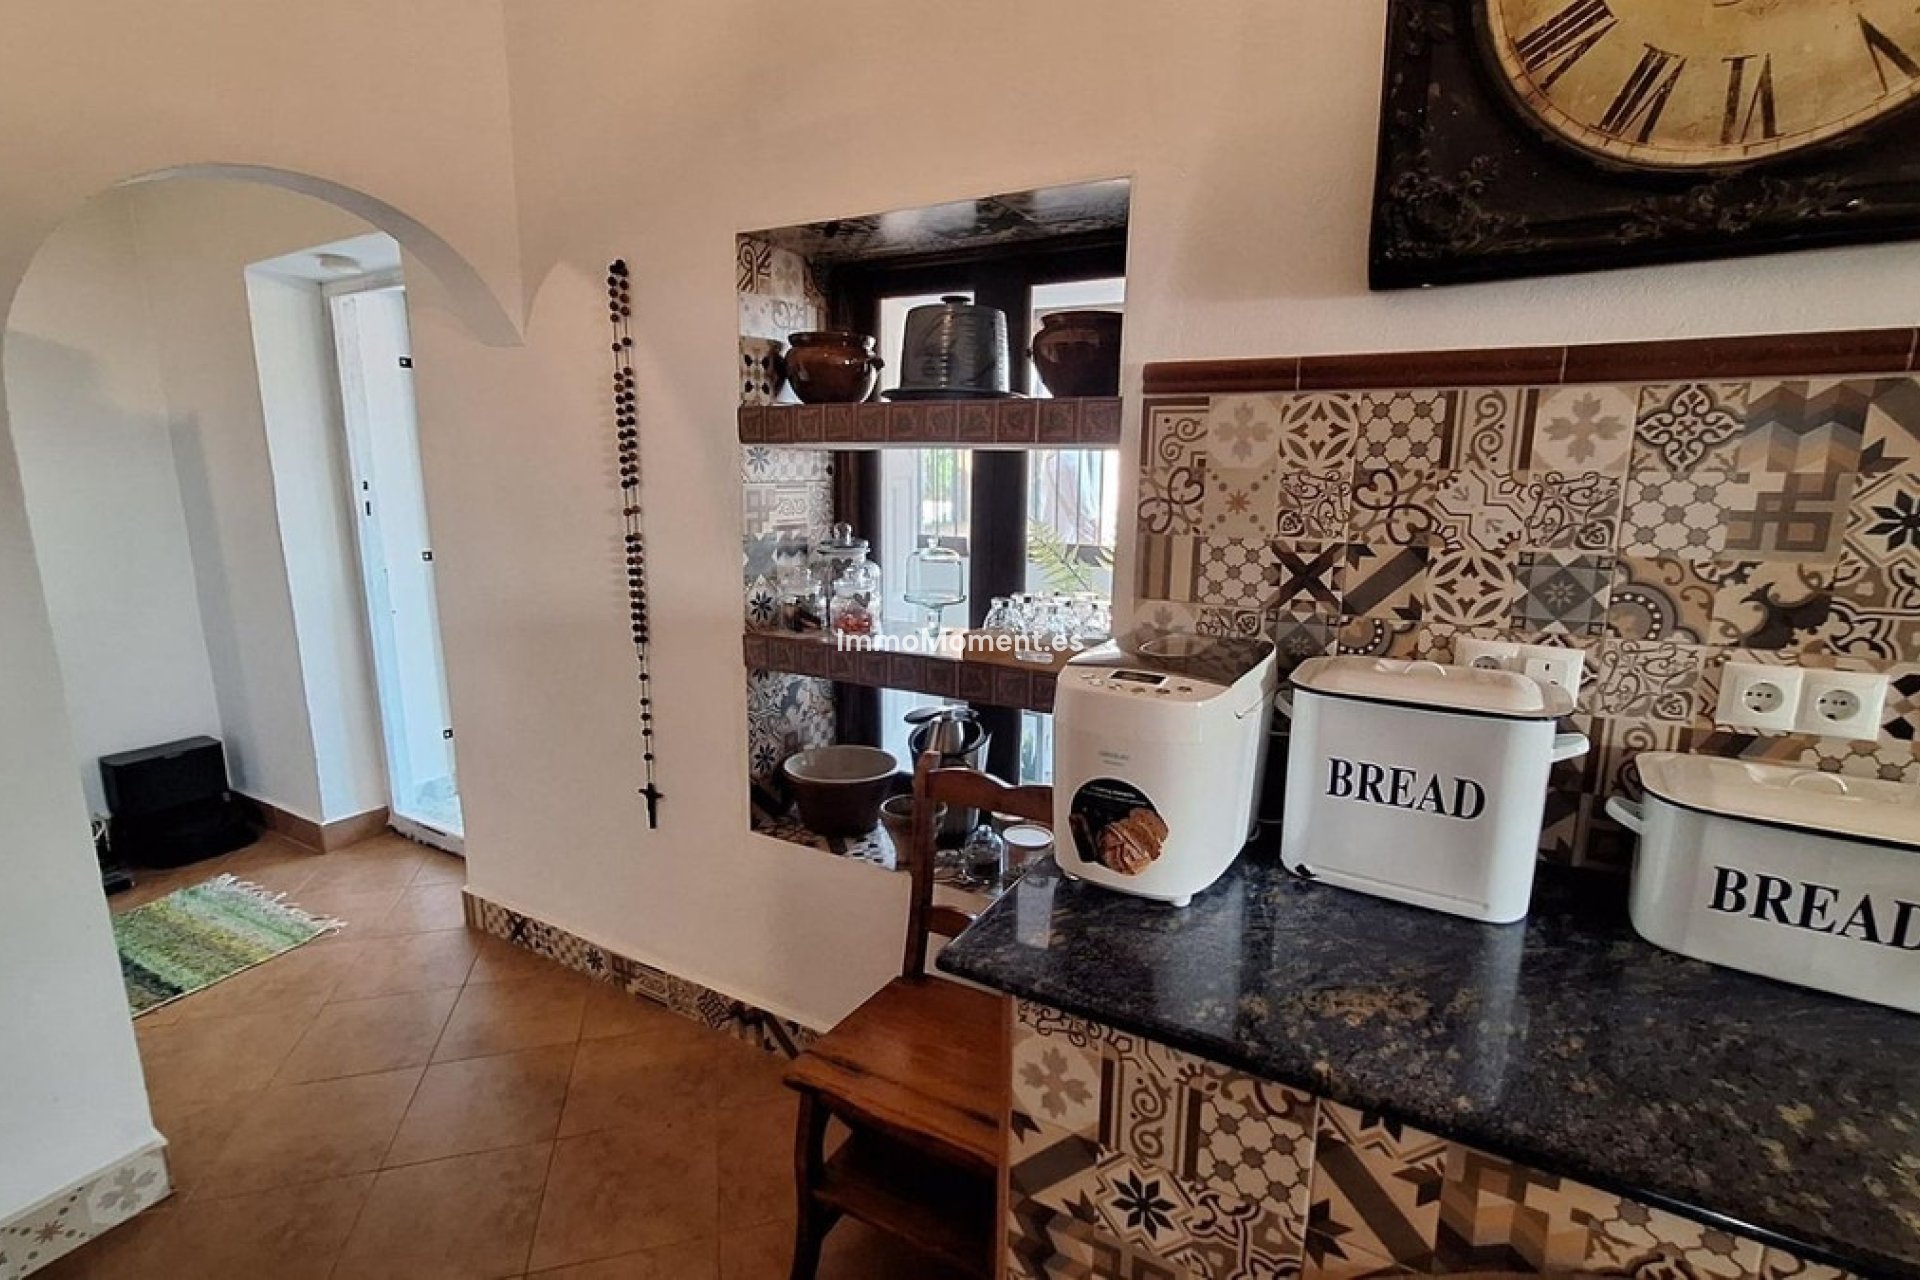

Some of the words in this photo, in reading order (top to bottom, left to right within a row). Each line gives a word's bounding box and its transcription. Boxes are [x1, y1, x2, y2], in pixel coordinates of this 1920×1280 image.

[1592, 43, 1688, 144] VII
[1720, 53, 1784, 144] VI
[1326, 757, 1486, 820] BREAD
